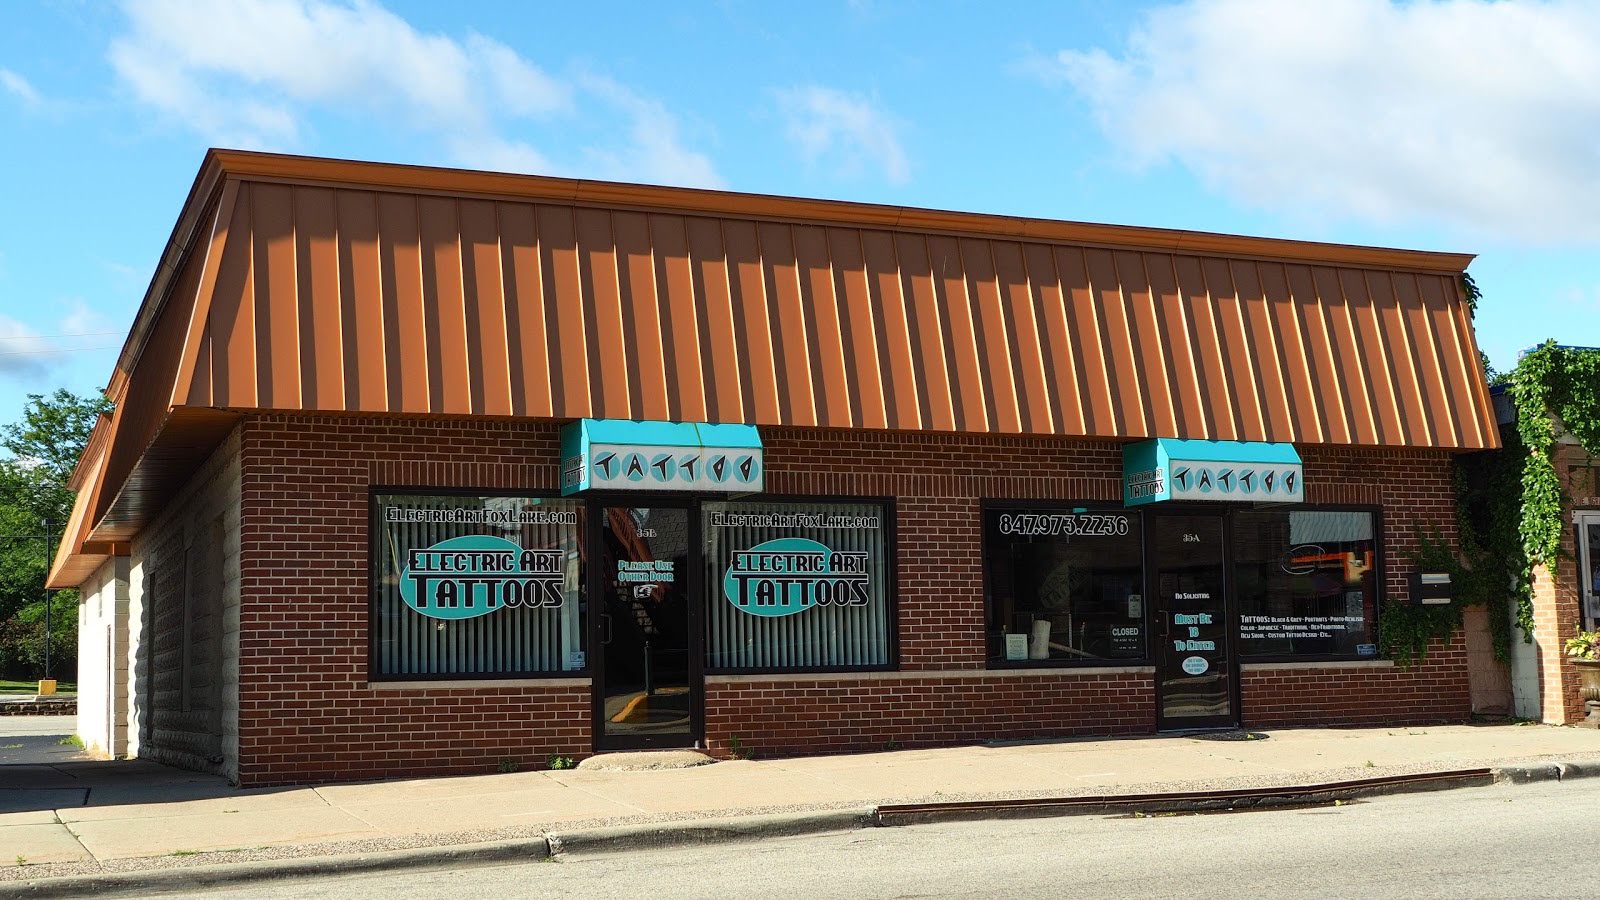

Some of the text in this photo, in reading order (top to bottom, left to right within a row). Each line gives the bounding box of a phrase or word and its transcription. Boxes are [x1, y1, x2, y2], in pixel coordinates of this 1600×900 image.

[594, 452, 753, 482] TATTOO
[1128, 479, 1165, 499] TATTOOS
[1173, 467, 1296, 494] TATTOO
[385, 506, 577, 524] ELECTRICARTFOXLAKE.COM
[710, 511, 879, 528] ELECTRICARTFOXLAKE.COM
[636, 528, 657, 538] 35B
[999, 513, 1129, 536] 847.973.2236
[1182, 533, 1201, 542] 35A
[408, 549, 564, 573] ELECTRIC ART
[618, 559, 674, 571] PLEASE USE
[731, 550, 868, 573] ELECTRIC ART
[618, 571, 674, 582] OTHER DOOR
[407, 573, 564, 609] TATTOOS
[731, 573, 869, 607] TATTOOS
[1174, 612, 1212, 625] MUST BE
[1112, 627, 1139, 636] CLOSED
[1188, 626, 1200, 638] 18
[1174, 640, 1215, 651] TO ENTER
